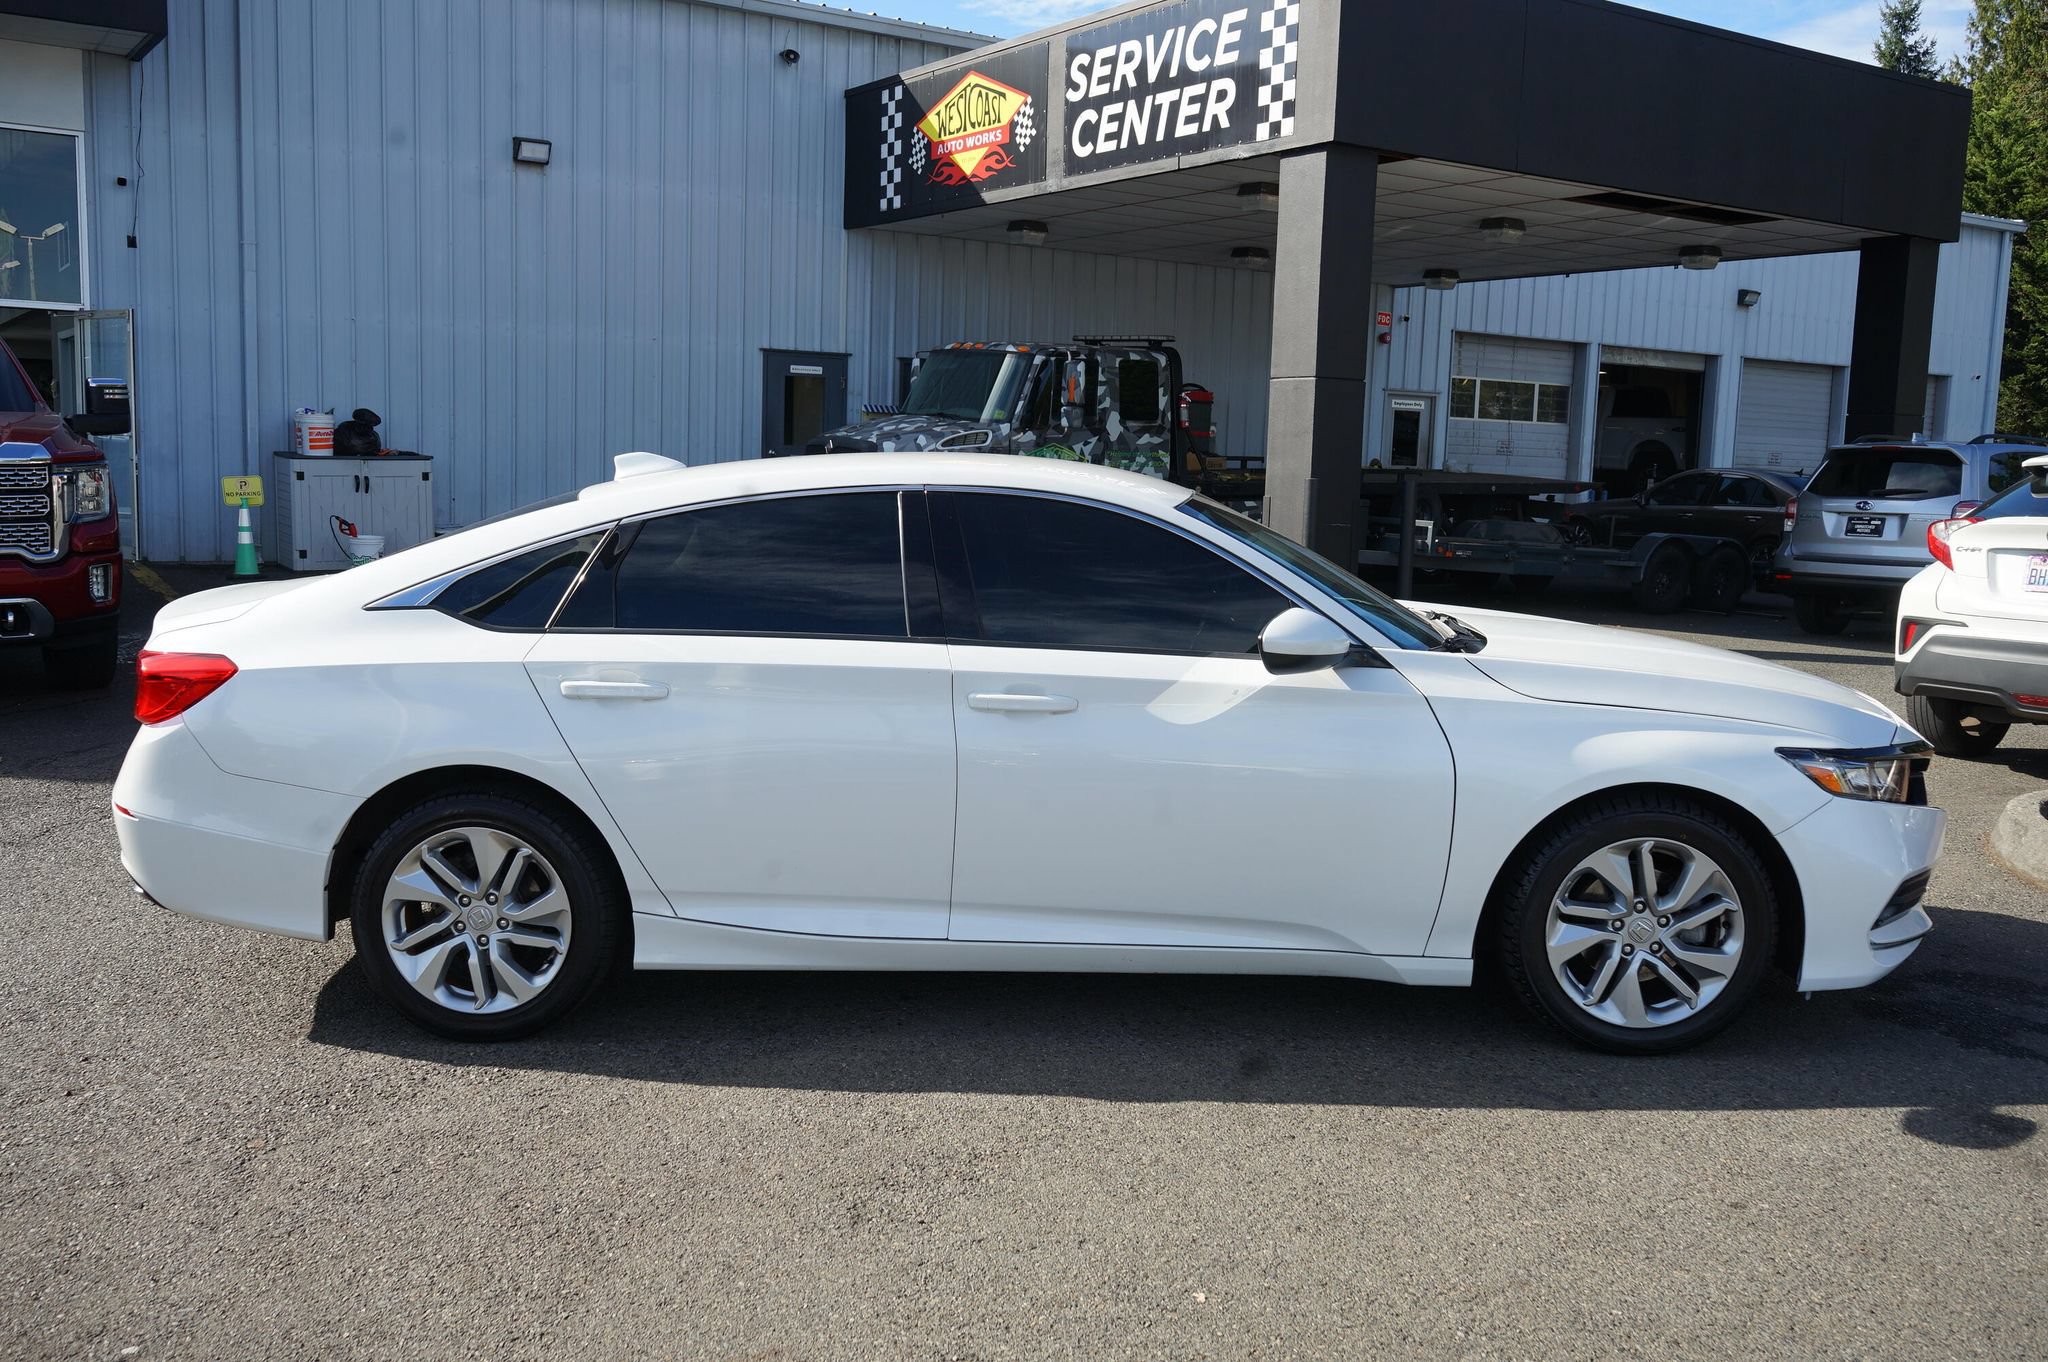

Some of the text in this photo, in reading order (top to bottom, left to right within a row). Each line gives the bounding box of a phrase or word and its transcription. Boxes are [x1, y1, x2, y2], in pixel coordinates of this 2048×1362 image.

[1065, 8, 1248, 102] SERVICE
[1071, 77, 1237, 158] CENTER
[937, 129, 1003, 155] AUTO WORKS
[1378, 315, 1390, 325] FDC
[2028, 568, 2048, 586] BH
